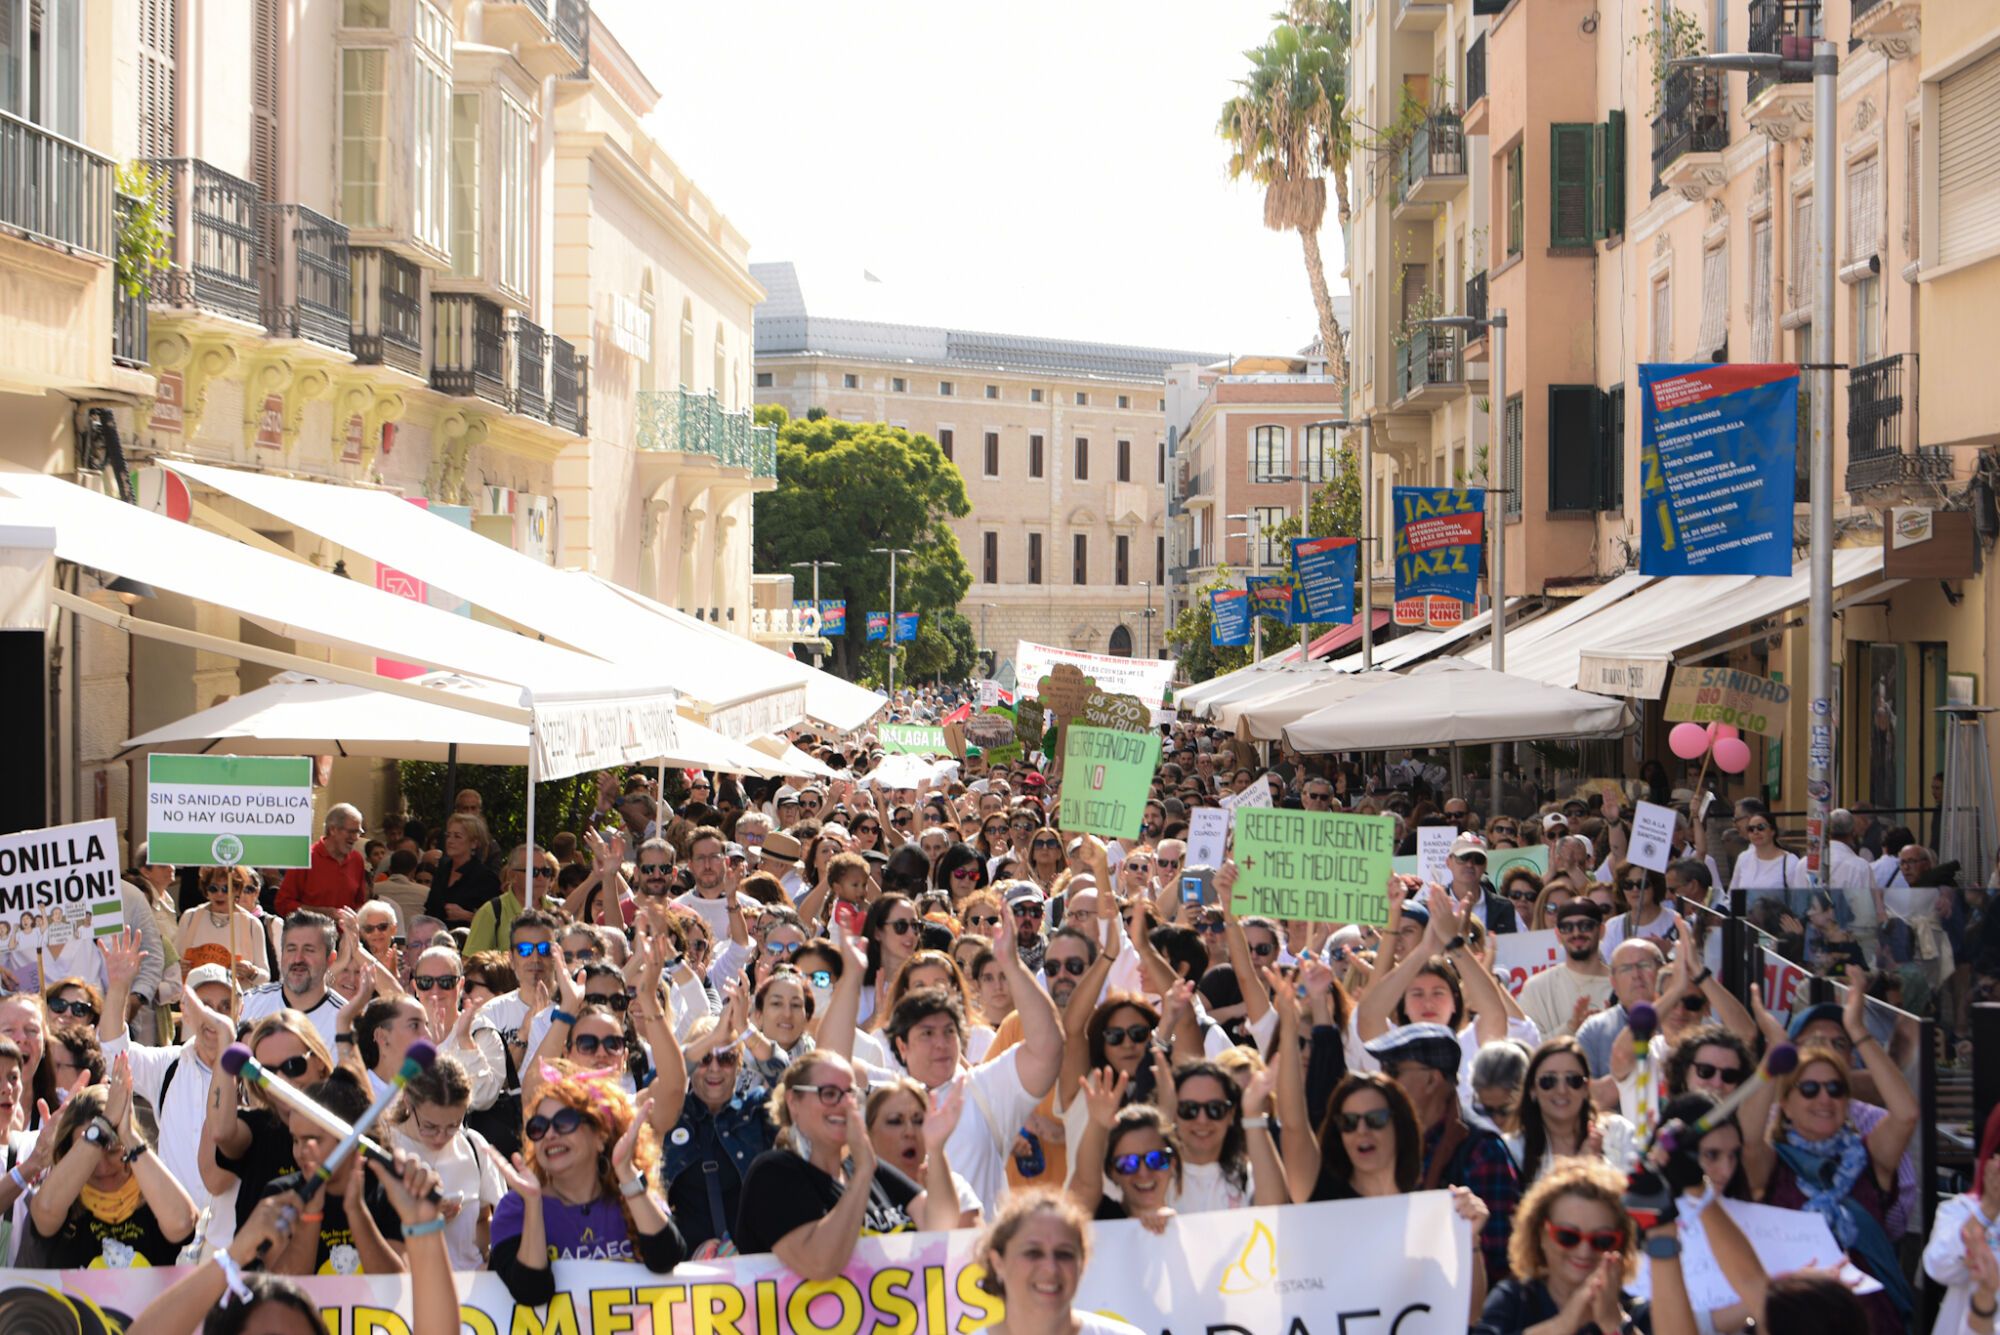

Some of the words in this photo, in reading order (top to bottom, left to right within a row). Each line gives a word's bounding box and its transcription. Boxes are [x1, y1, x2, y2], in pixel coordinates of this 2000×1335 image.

[1654, 417, 1689, 433] KANDACE
[1690, 409, 1722, 424] SPRINGS
[1658, 434, 1692, 449] GUSTAVO
[1693, 420, 1745, 440] SANTAOLALLA
[1663, 458, 1683, 470] THEO
[1684, 450, 1714, 464] CROKER
[1667, 472, 1694, 484] VICTOR
[1695, 464, 1729, 476] WOOTEN
[1669, 484, 1683, 493] THE
[1684, 474, 1717, 489] WOOTEN
[1718, 464, 1756, 480] BROTHERS
[1730, 478, 1764, 494] SALVANT
[1403, 490, 1474, 522] JAZZ
[1678, 511, 1711, 524] MAMMAL
[1712, 502, 1738, 516] HANDS
[1410, 523, 1462, 538] INTERNACIONAL
[1417, 520, 1445, 530] FESTIVAL
[1681, 530, 1690, 539] AL
[1700, 522, 1727, 534] MEOLA
[1420, 534, 1436, 542] JAZZ
[1687, 548, 1715, 560] AVISHAI
[1716, 541, 1741, 552] COHEN
[1742, 532, 1774, 546] QUINTET
[1403, 546, 1470, 586] JAZZ
[1396, 602, 1425, 610] BURGER
[1396, 608, 1424, 618] KING
[1430, 602, 1462, 610] BURGER
[1430, 610, 1461, 620] KING
[1700, 668, 1790, 704] SANIDAD
[1088, 692, 1106, 708] LOS
[1108, 700, 1141, 720] 700
[1696, 688, 1721, 704] NO
[1726, 692, 1754, 712] ES
[1086, 708, 1110, 725] SON
[1692, 704, 1768, 732] NEGOCIO
[880, 726, 930, 746] MÁLAGA
[1084, 764, 1106, 790] NO
[150, 792, 173, 804] SIN
[177, 794, 242, 806] SANIDAD
[246, 792, 309, 808] PÚBLICA
[163, 810, 184, 822] NO
[188, 811, 216, 822] HAY
[220, 812, 296, 825] IGUALDAD
[1245, 813, 1304, 846] RECETA
[1432, 832, 1442, 840] LA
[1252, 886, 1298, 916] MENOS
[1273, 1278, 1324, 1295] ESTATAL
